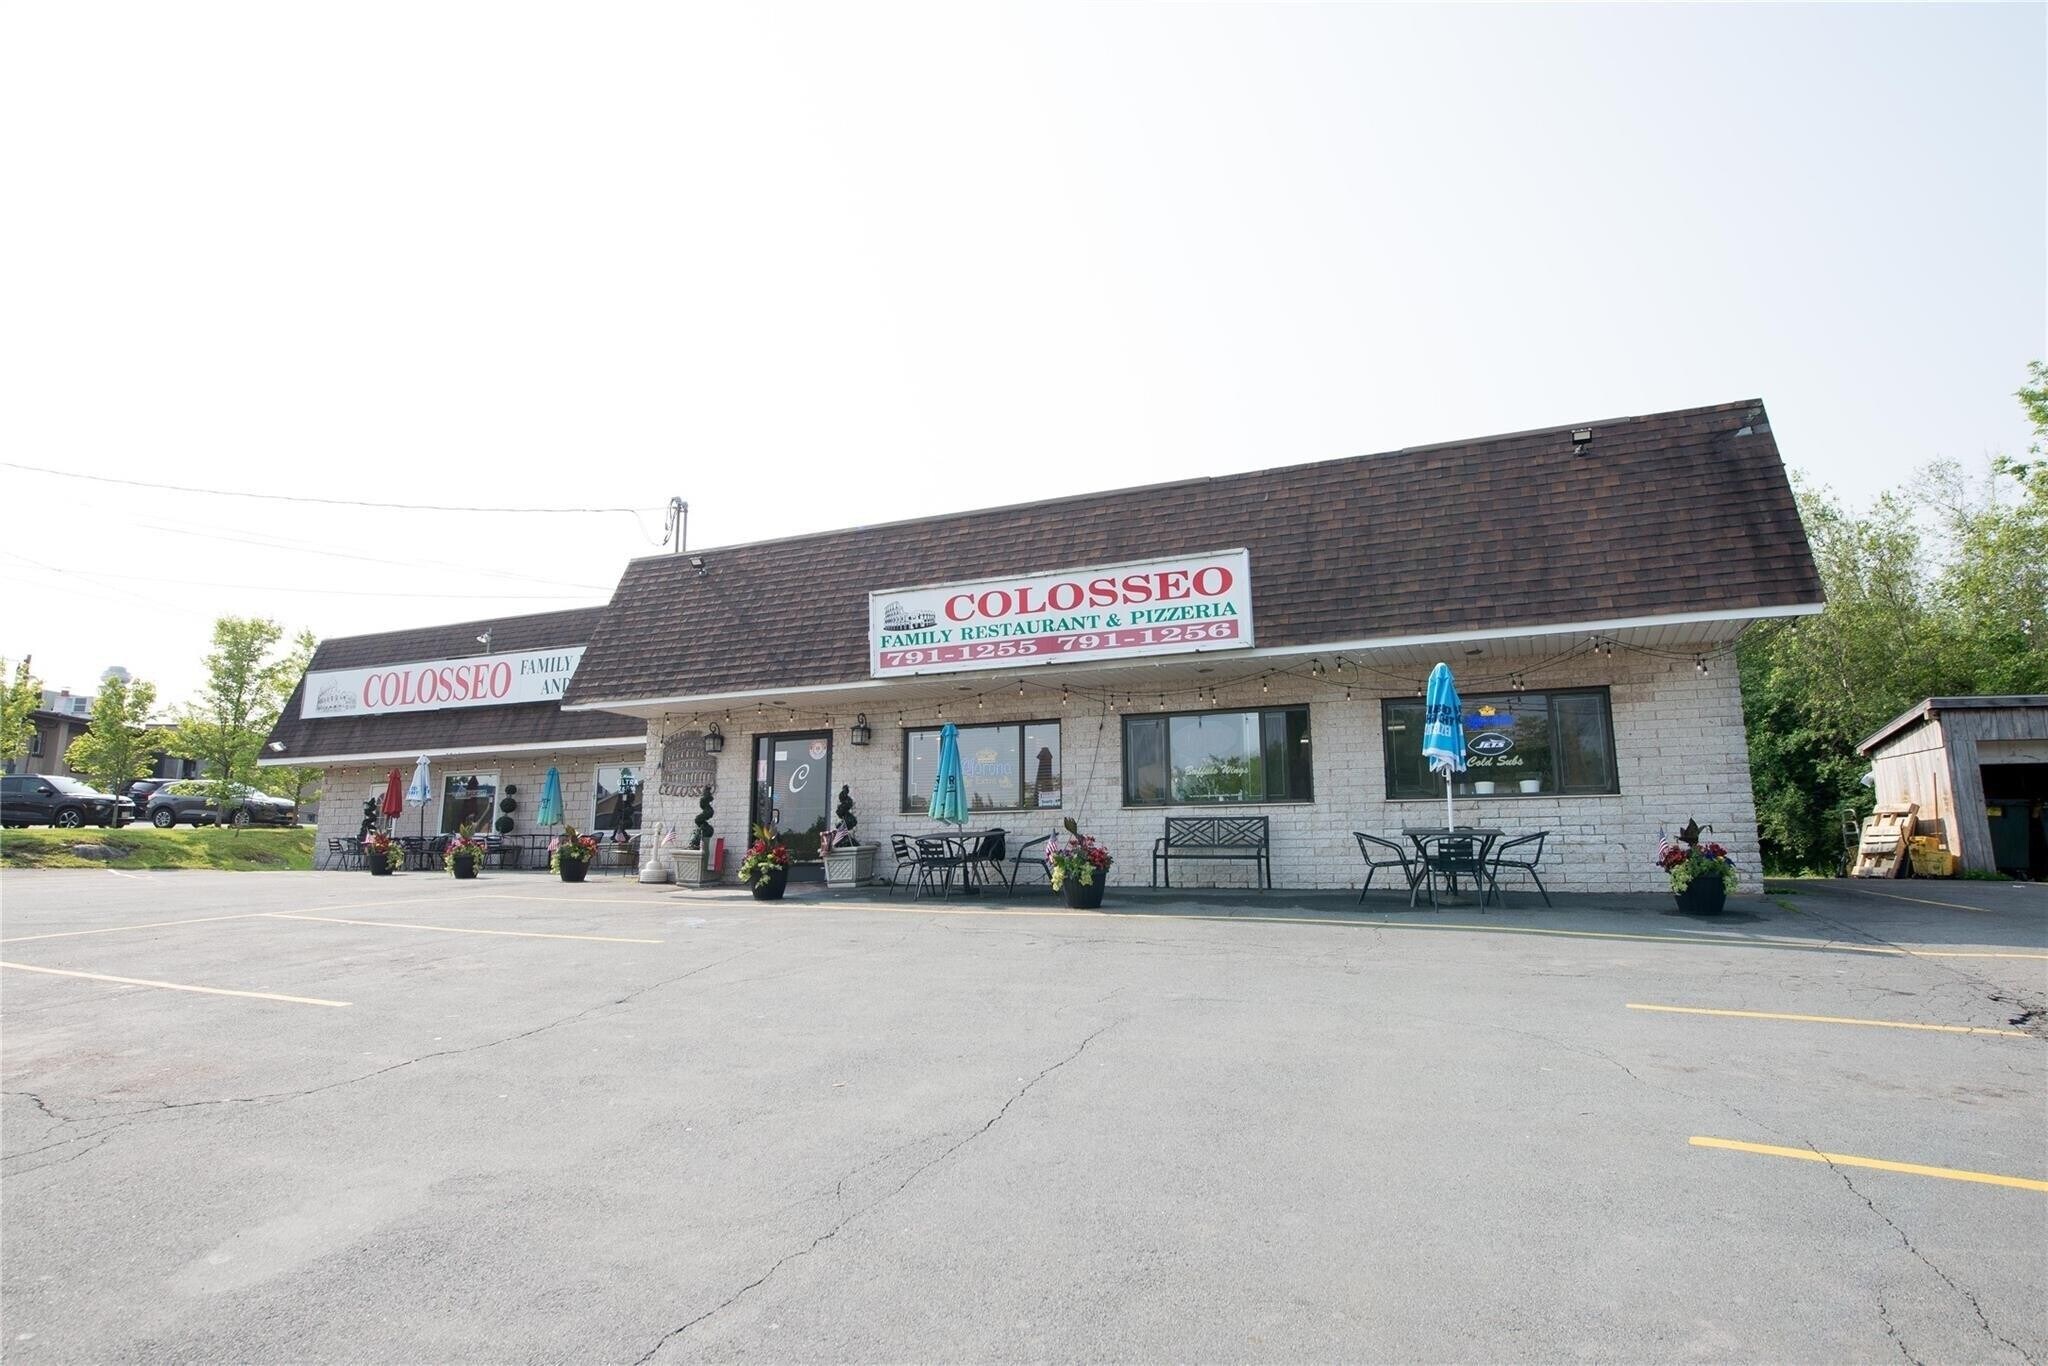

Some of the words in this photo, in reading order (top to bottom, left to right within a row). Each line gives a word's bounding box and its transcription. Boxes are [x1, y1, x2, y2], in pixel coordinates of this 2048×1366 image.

[944, 566, 1233, 622] COLOSSEO
[880, 629, 953, 649] FAMILY
[960, 615, 1101, 640] RESTAURANT
[1105, 612, 1122, 628] &
[1130, 601, 1238, 626] PIZZERIA
[886, 639, 1038, 666] 791-1255
[1056, 622, 1232, 651] 791-1256
[520, 655, 573, 675] FAMILY
[363, 661, 512, 708] COLOSSEO
[1475, 738, 1506, 749] JETS
[1184, 765, 1219, 778] Buffalo
[1220, 765, 1249, 777] Wings
[1466, 756, 1493, 767] Cold
[1497, 755, 1524, 766] Subs
[658, 783, 717, 797] COLOSSO
[789, 763, 810, 793] C
